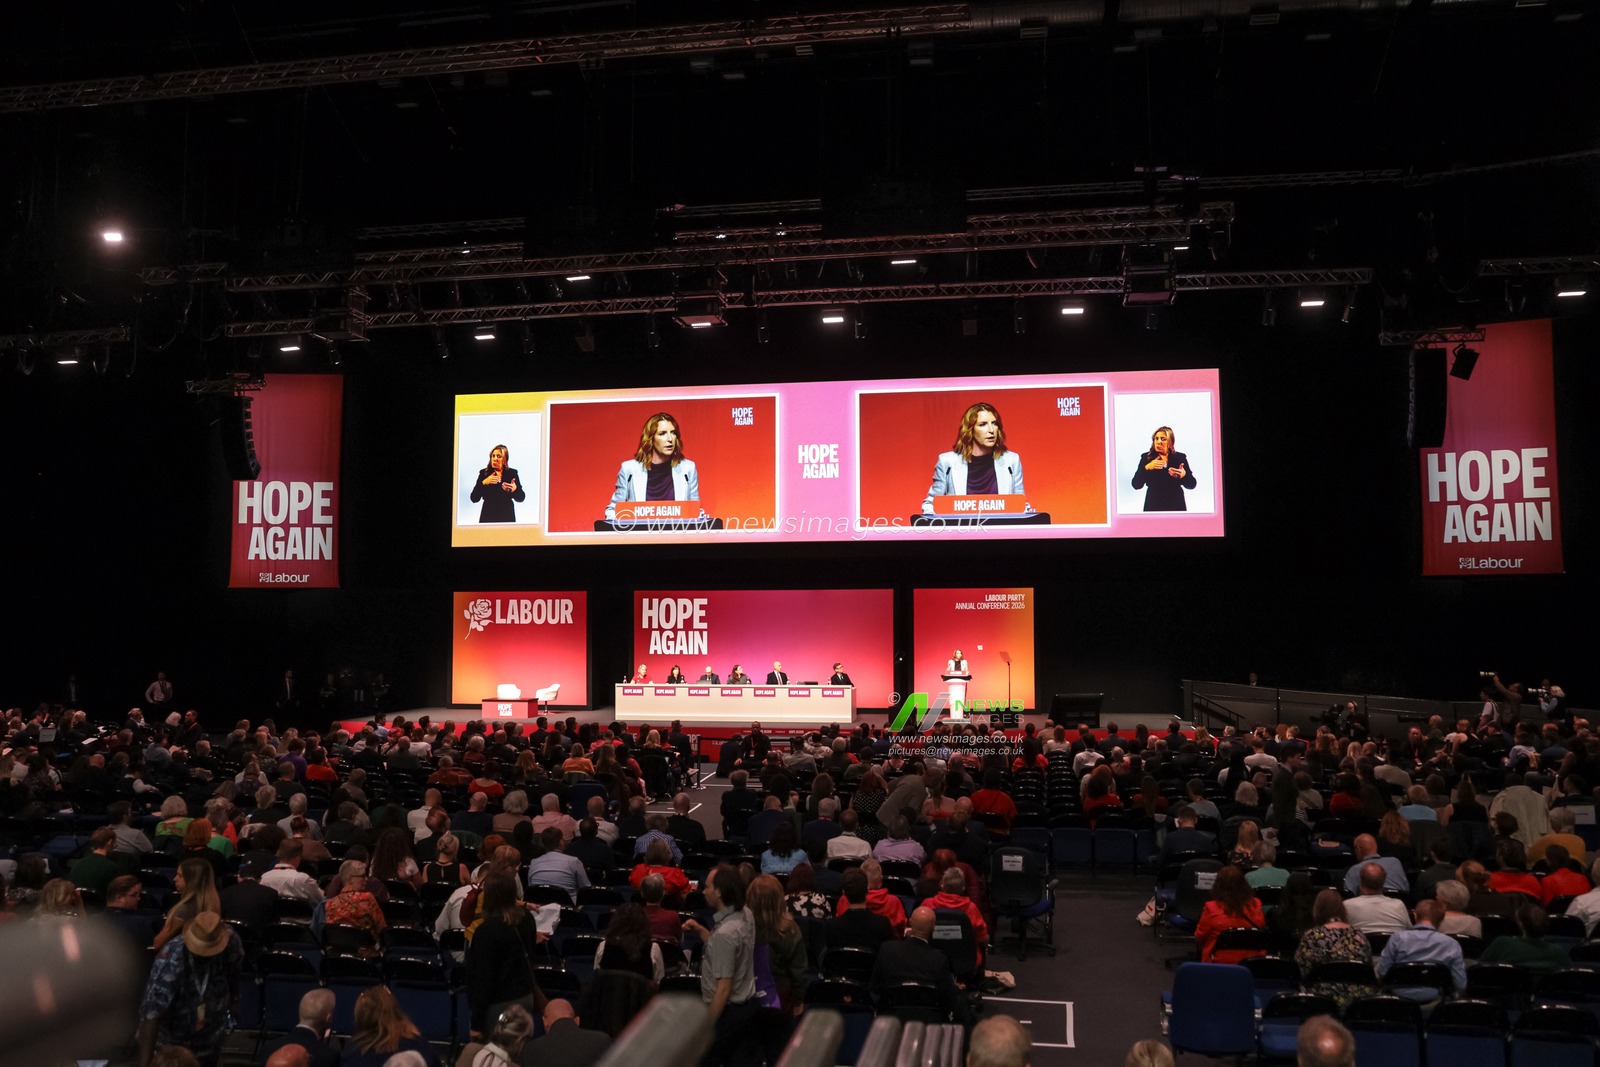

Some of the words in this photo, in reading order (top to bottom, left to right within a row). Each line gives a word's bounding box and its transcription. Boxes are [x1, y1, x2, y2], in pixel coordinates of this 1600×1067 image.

[1057, 397, 1080, 409] HOPE
[732, 407, 753, 418] HOPE
[1060, 407, 1080, 417] AGAIN
[734, 417, 753, 426] AGAIN
[798, 443, 839, 464] HOPE
[802, 463, 839, 479] AGAIN
[1427, 447, 1551, 502] HOPE
[238, 481, 334, 524] HOPE
[954, 499, 977, 511] HOPE
[978, 499, 1005, 511] AGAIN
[634, 506, 654, 518] HOPE
[656, 505, 681, 517] AGAIN
[1443, 501, 1553, 543] AGAIN
[247, 526, 333, 560] AGAIN
[1472, 557, 1523, 569] Labour
[269, 573, 309, 583] Labour
[985, 594, 1007, 602] LABOUR
[1007, 593, 1025, 601] PARTY
[495, 598, 574, 625] LABOUR
[955, 602, 976, 610] ANNUAL
[976, 602, 1010, 610] CONFERENCE
[1011, 601, 1025, 609] 2026
[642, 597, 708, 629] HOPE
[649, 630, 708, 655] AGAIN
